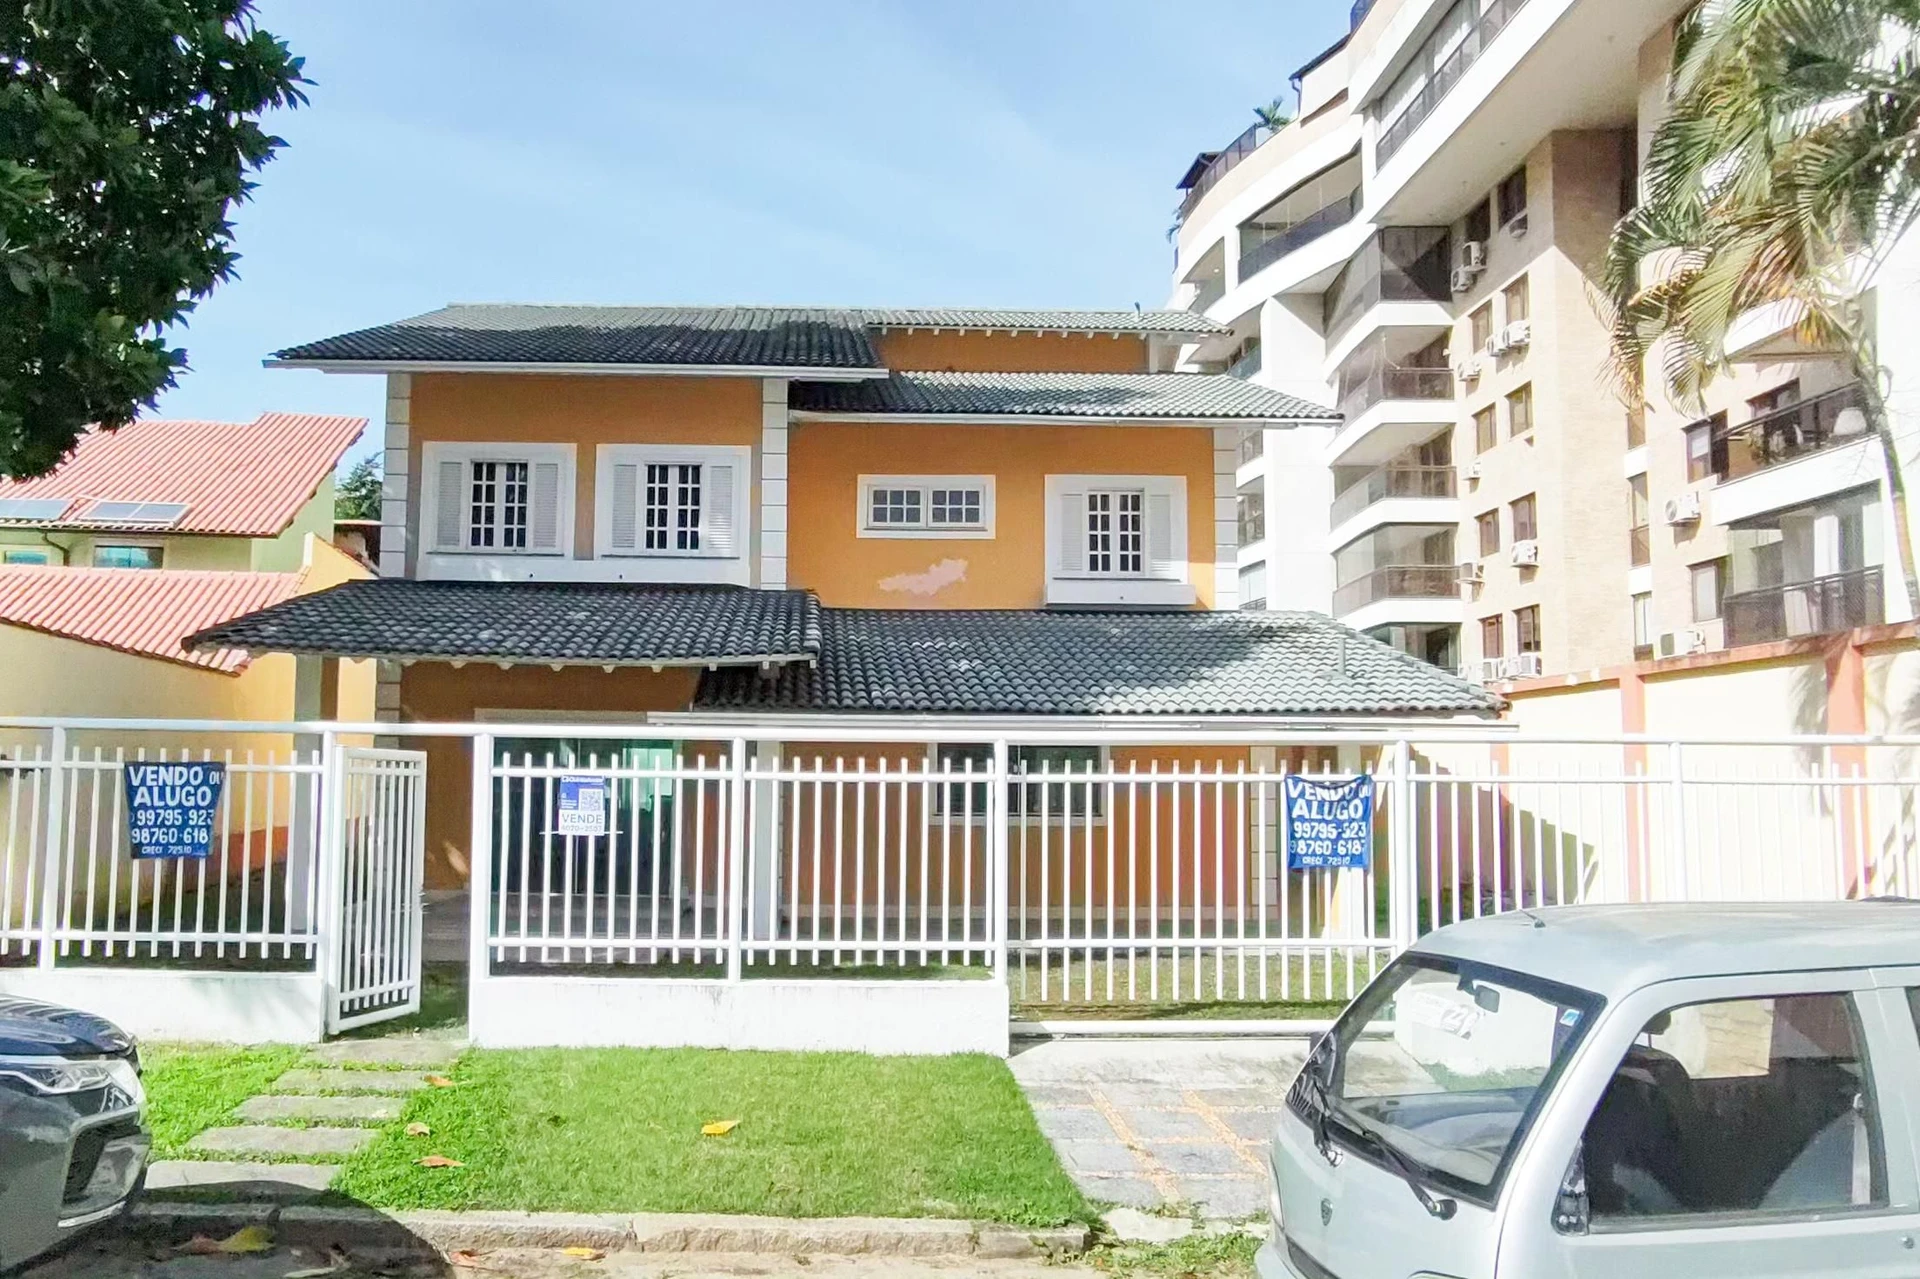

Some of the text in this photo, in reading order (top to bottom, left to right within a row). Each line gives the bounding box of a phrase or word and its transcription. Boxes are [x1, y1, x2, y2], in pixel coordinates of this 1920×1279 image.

[128, 766, 204, 786] VENDO
[133, 786, 212, 807] ALUGO
[1286, 778, 1358, 803] VENDO
[561, 813, 603, 824] VENDE
[1291, 798, 1364, 820] ALUGO
